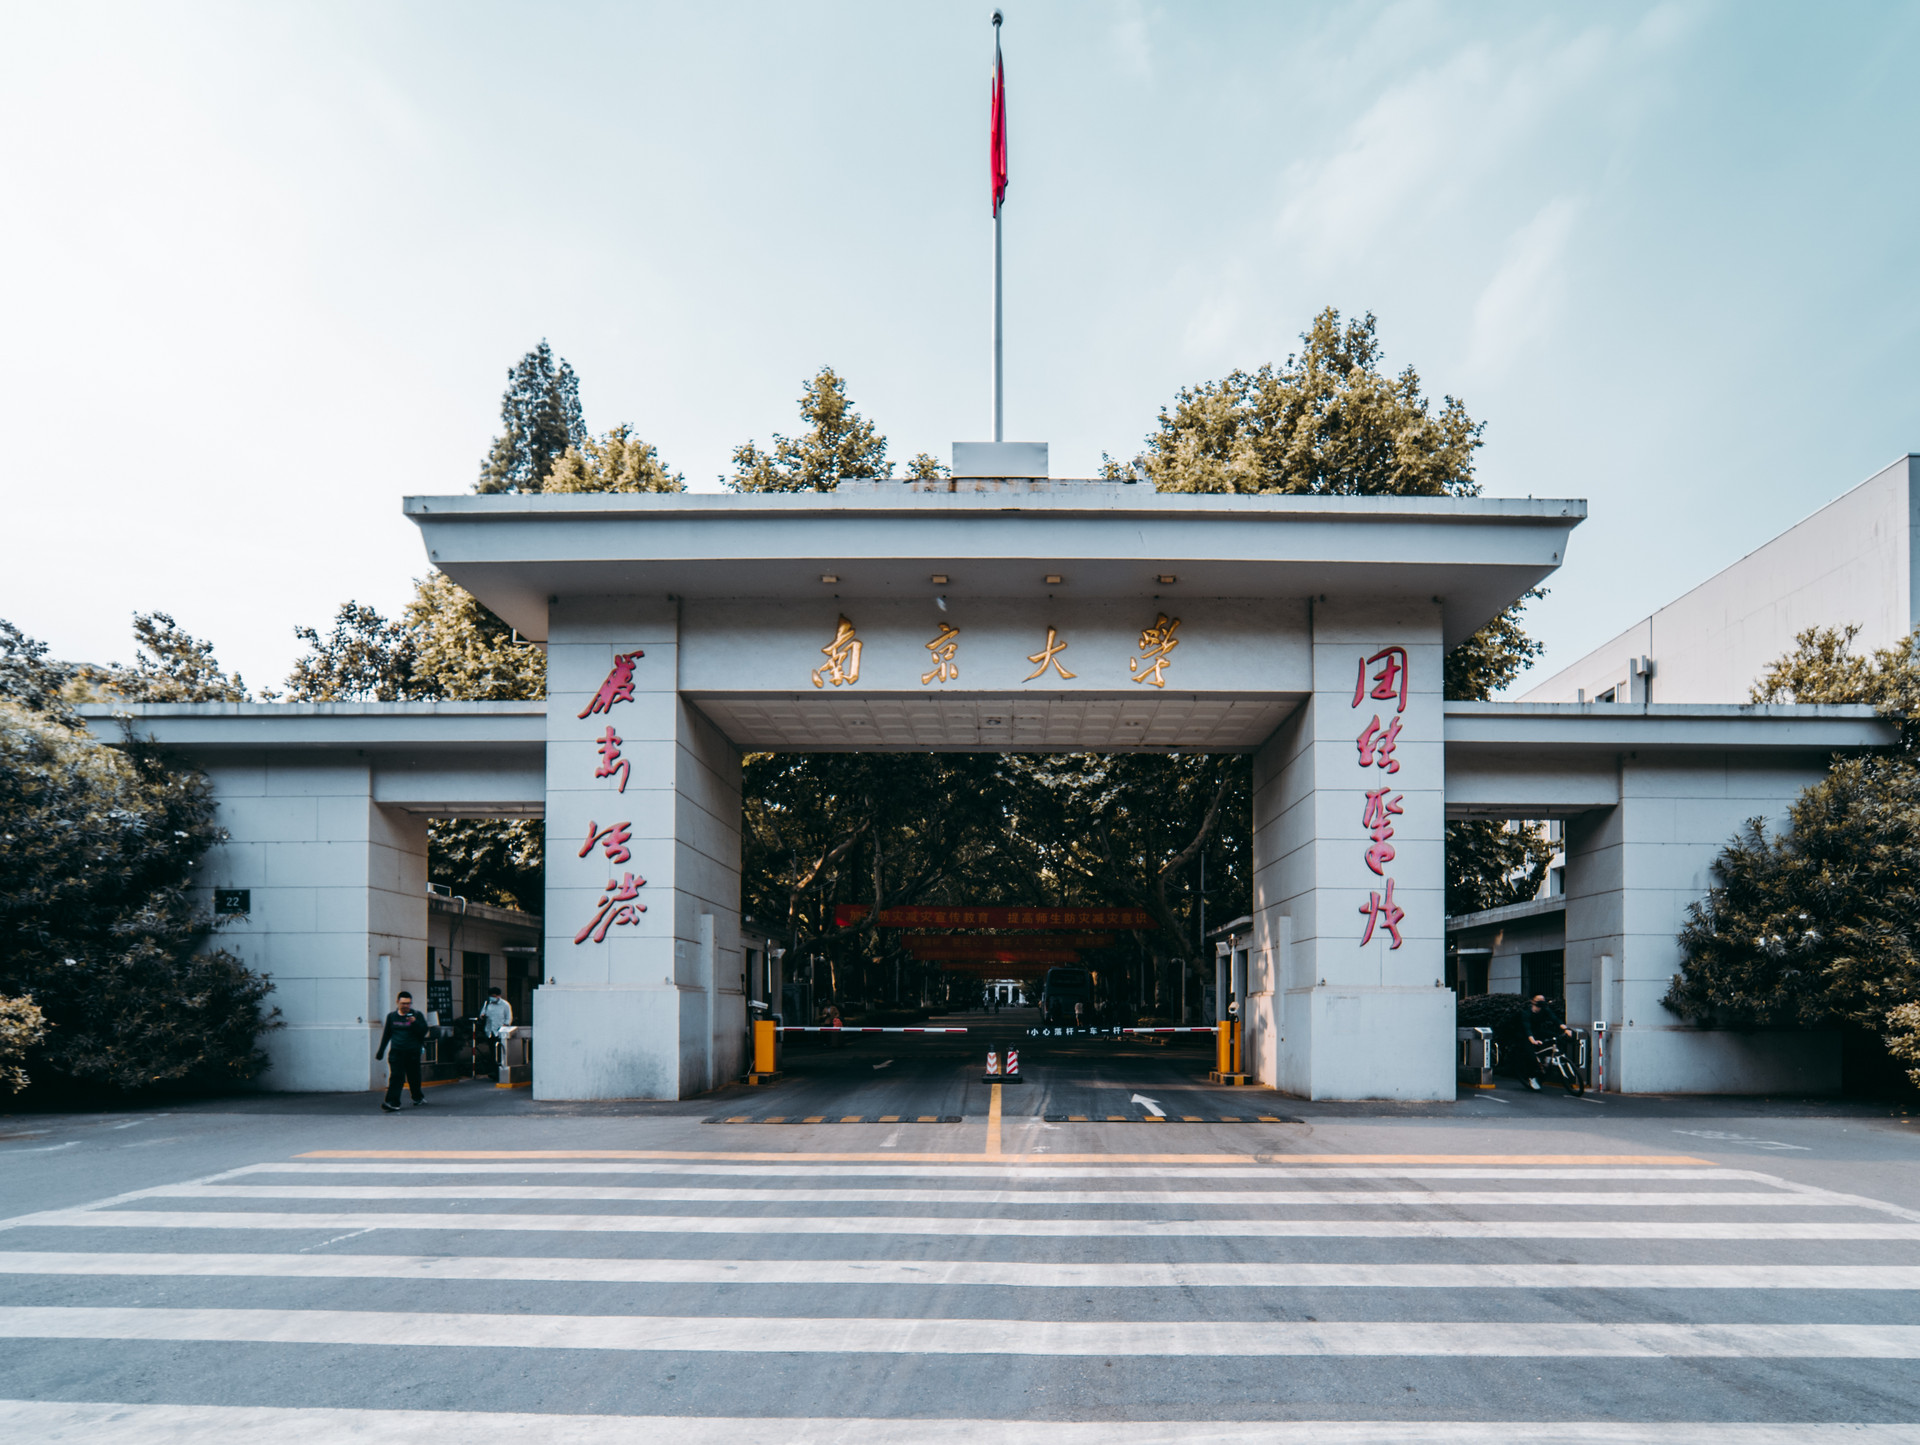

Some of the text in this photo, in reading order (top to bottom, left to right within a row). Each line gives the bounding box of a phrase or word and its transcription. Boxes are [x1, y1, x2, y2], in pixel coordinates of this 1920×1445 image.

[226, 896, 240, 907] 22
[849, 910, 1148, 925] 加防灾减灾宣传教育 提高师生防灾减灾意识
[1030, 1026, 1121, 1037] 小心落杆一车一杆
